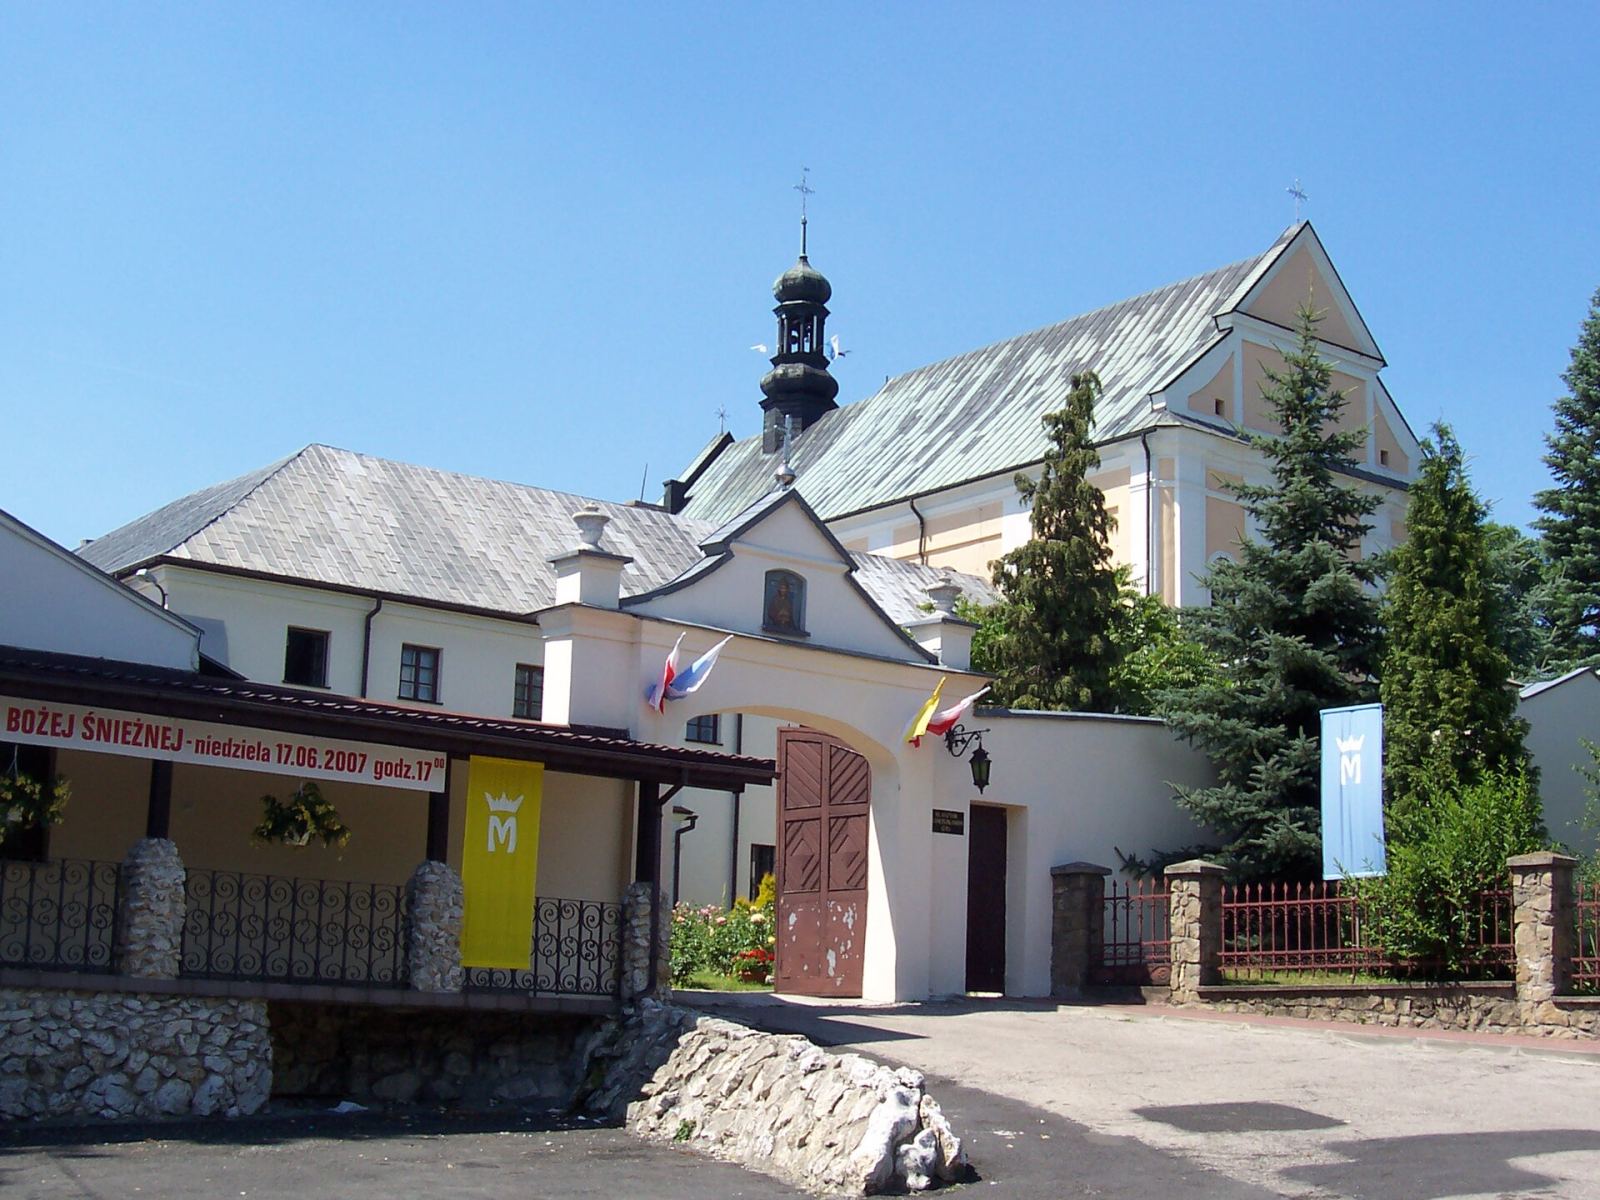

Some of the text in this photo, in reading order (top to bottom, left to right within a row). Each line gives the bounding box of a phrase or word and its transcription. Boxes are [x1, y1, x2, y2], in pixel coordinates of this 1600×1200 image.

[6, 706, 75, 738] BOŻEJ
[82, 711, 184, 752] ŚNIEŻNEJ
[276, 743, 368, 774] 17.06.2007
[1340, 753, 1361, 786] M
[487, 815, 518, 854] M
